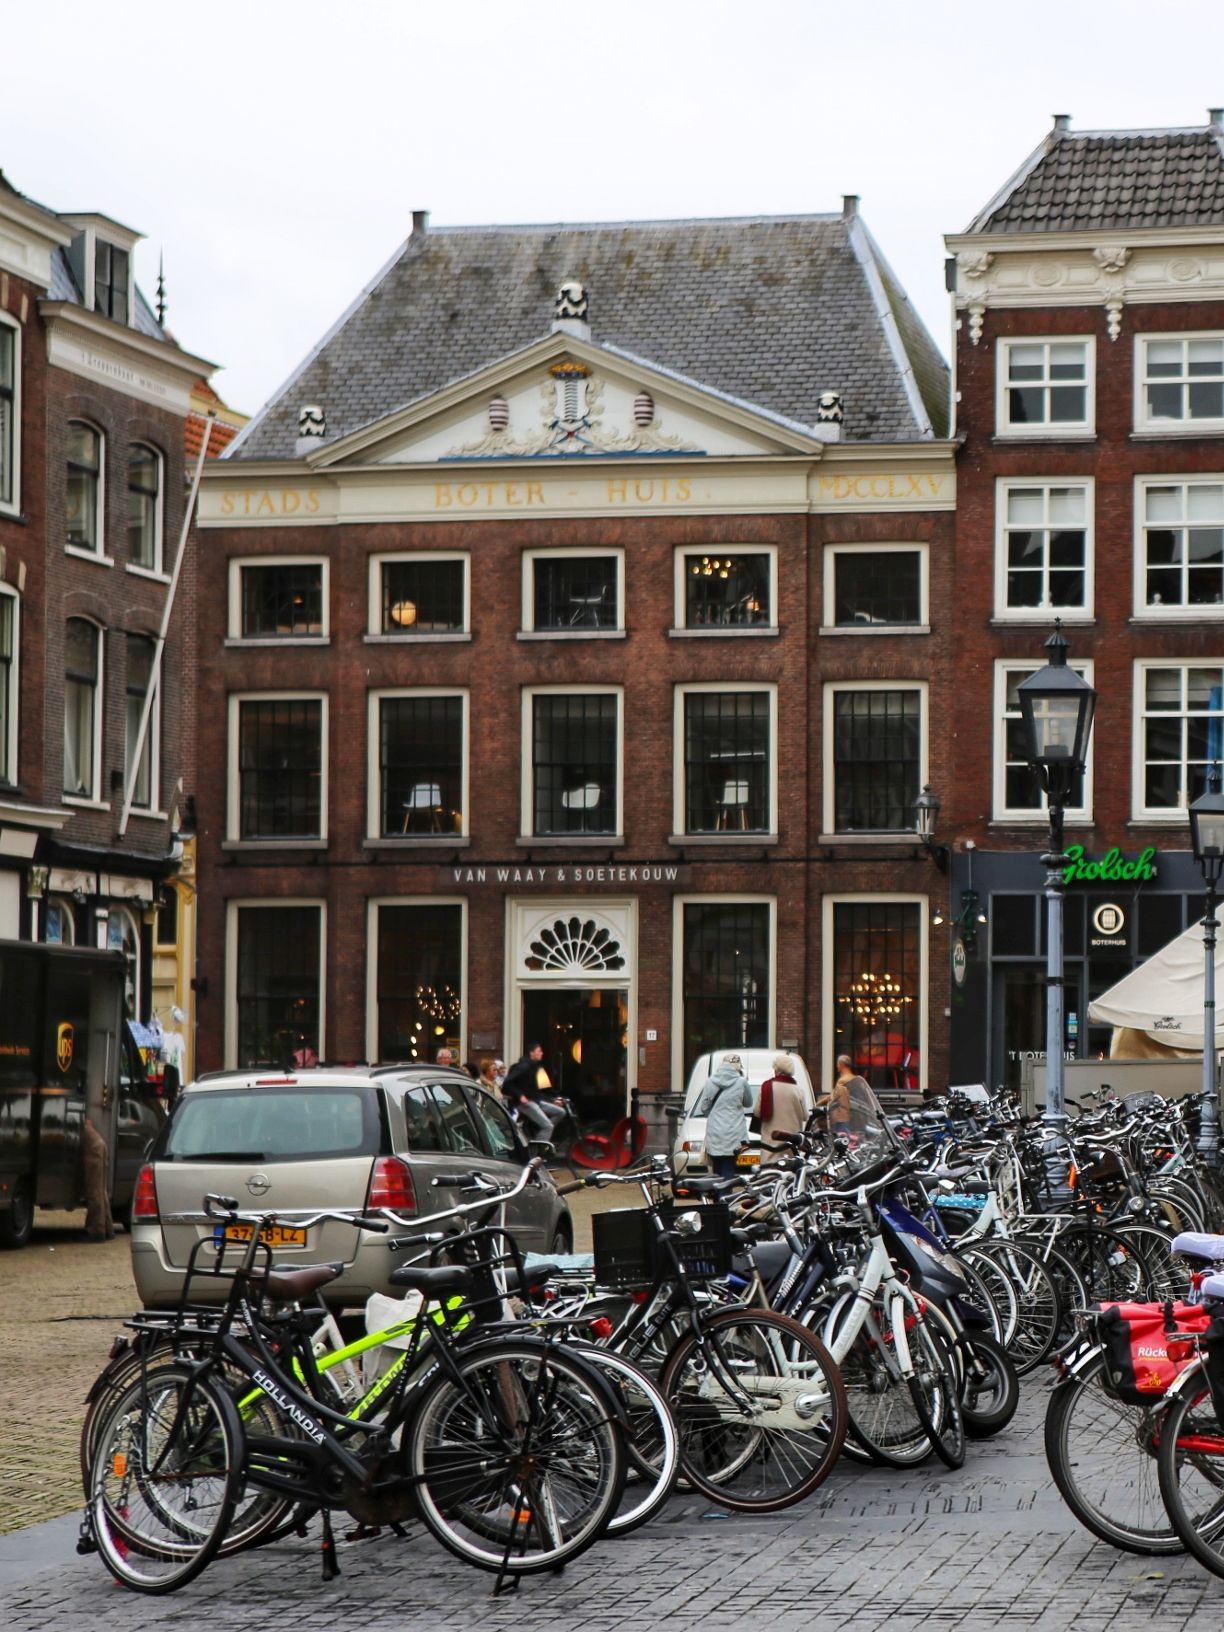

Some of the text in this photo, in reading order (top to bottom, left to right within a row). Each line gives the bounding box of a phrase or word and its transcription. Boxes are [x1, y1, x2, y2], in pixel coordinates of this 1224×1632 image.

[220, 489, 322, 514] STADS
[434, 481, 546, 508] BOTER
[606, 477, 692, 503] HUIS
[454, 867, 679, 882] VAN WAAY & SOETEKOUW
[1063, 845, 1155, 885] Grolsch
[1091, 938, 1127, 946] BOTERHUIS
[627, 1325, 658, 1359] GUE
[253, 1369, 326, 1446] HOLLANDIA
